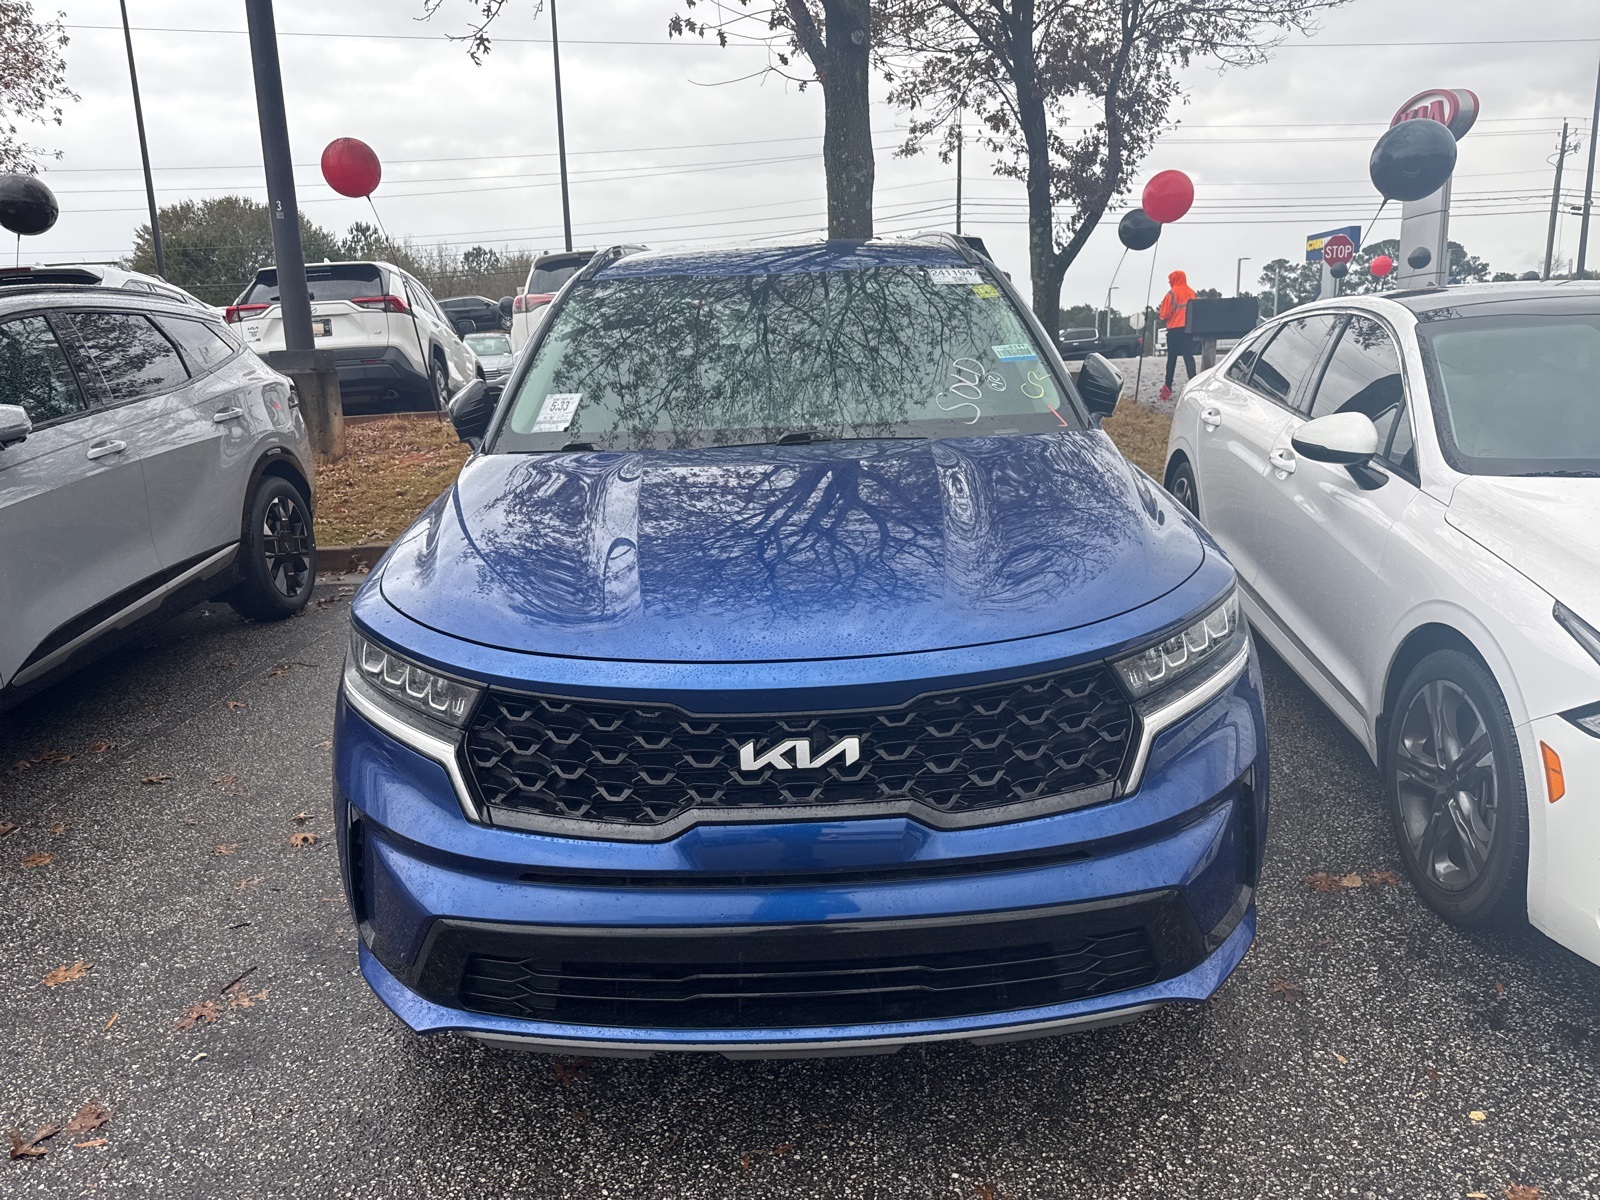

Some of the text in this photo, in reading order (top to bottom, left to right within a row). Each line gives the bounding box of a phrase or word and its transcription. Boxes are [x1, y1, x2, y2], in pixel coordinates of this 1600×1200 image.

[276, 200, 282, 211] 3
[1325, 245, 1352, 258] STOP
[930, 269, 978, 277] 2411947
[936, 357, 986, 424] SOLD
[740, 736, 860, 771] KIA
